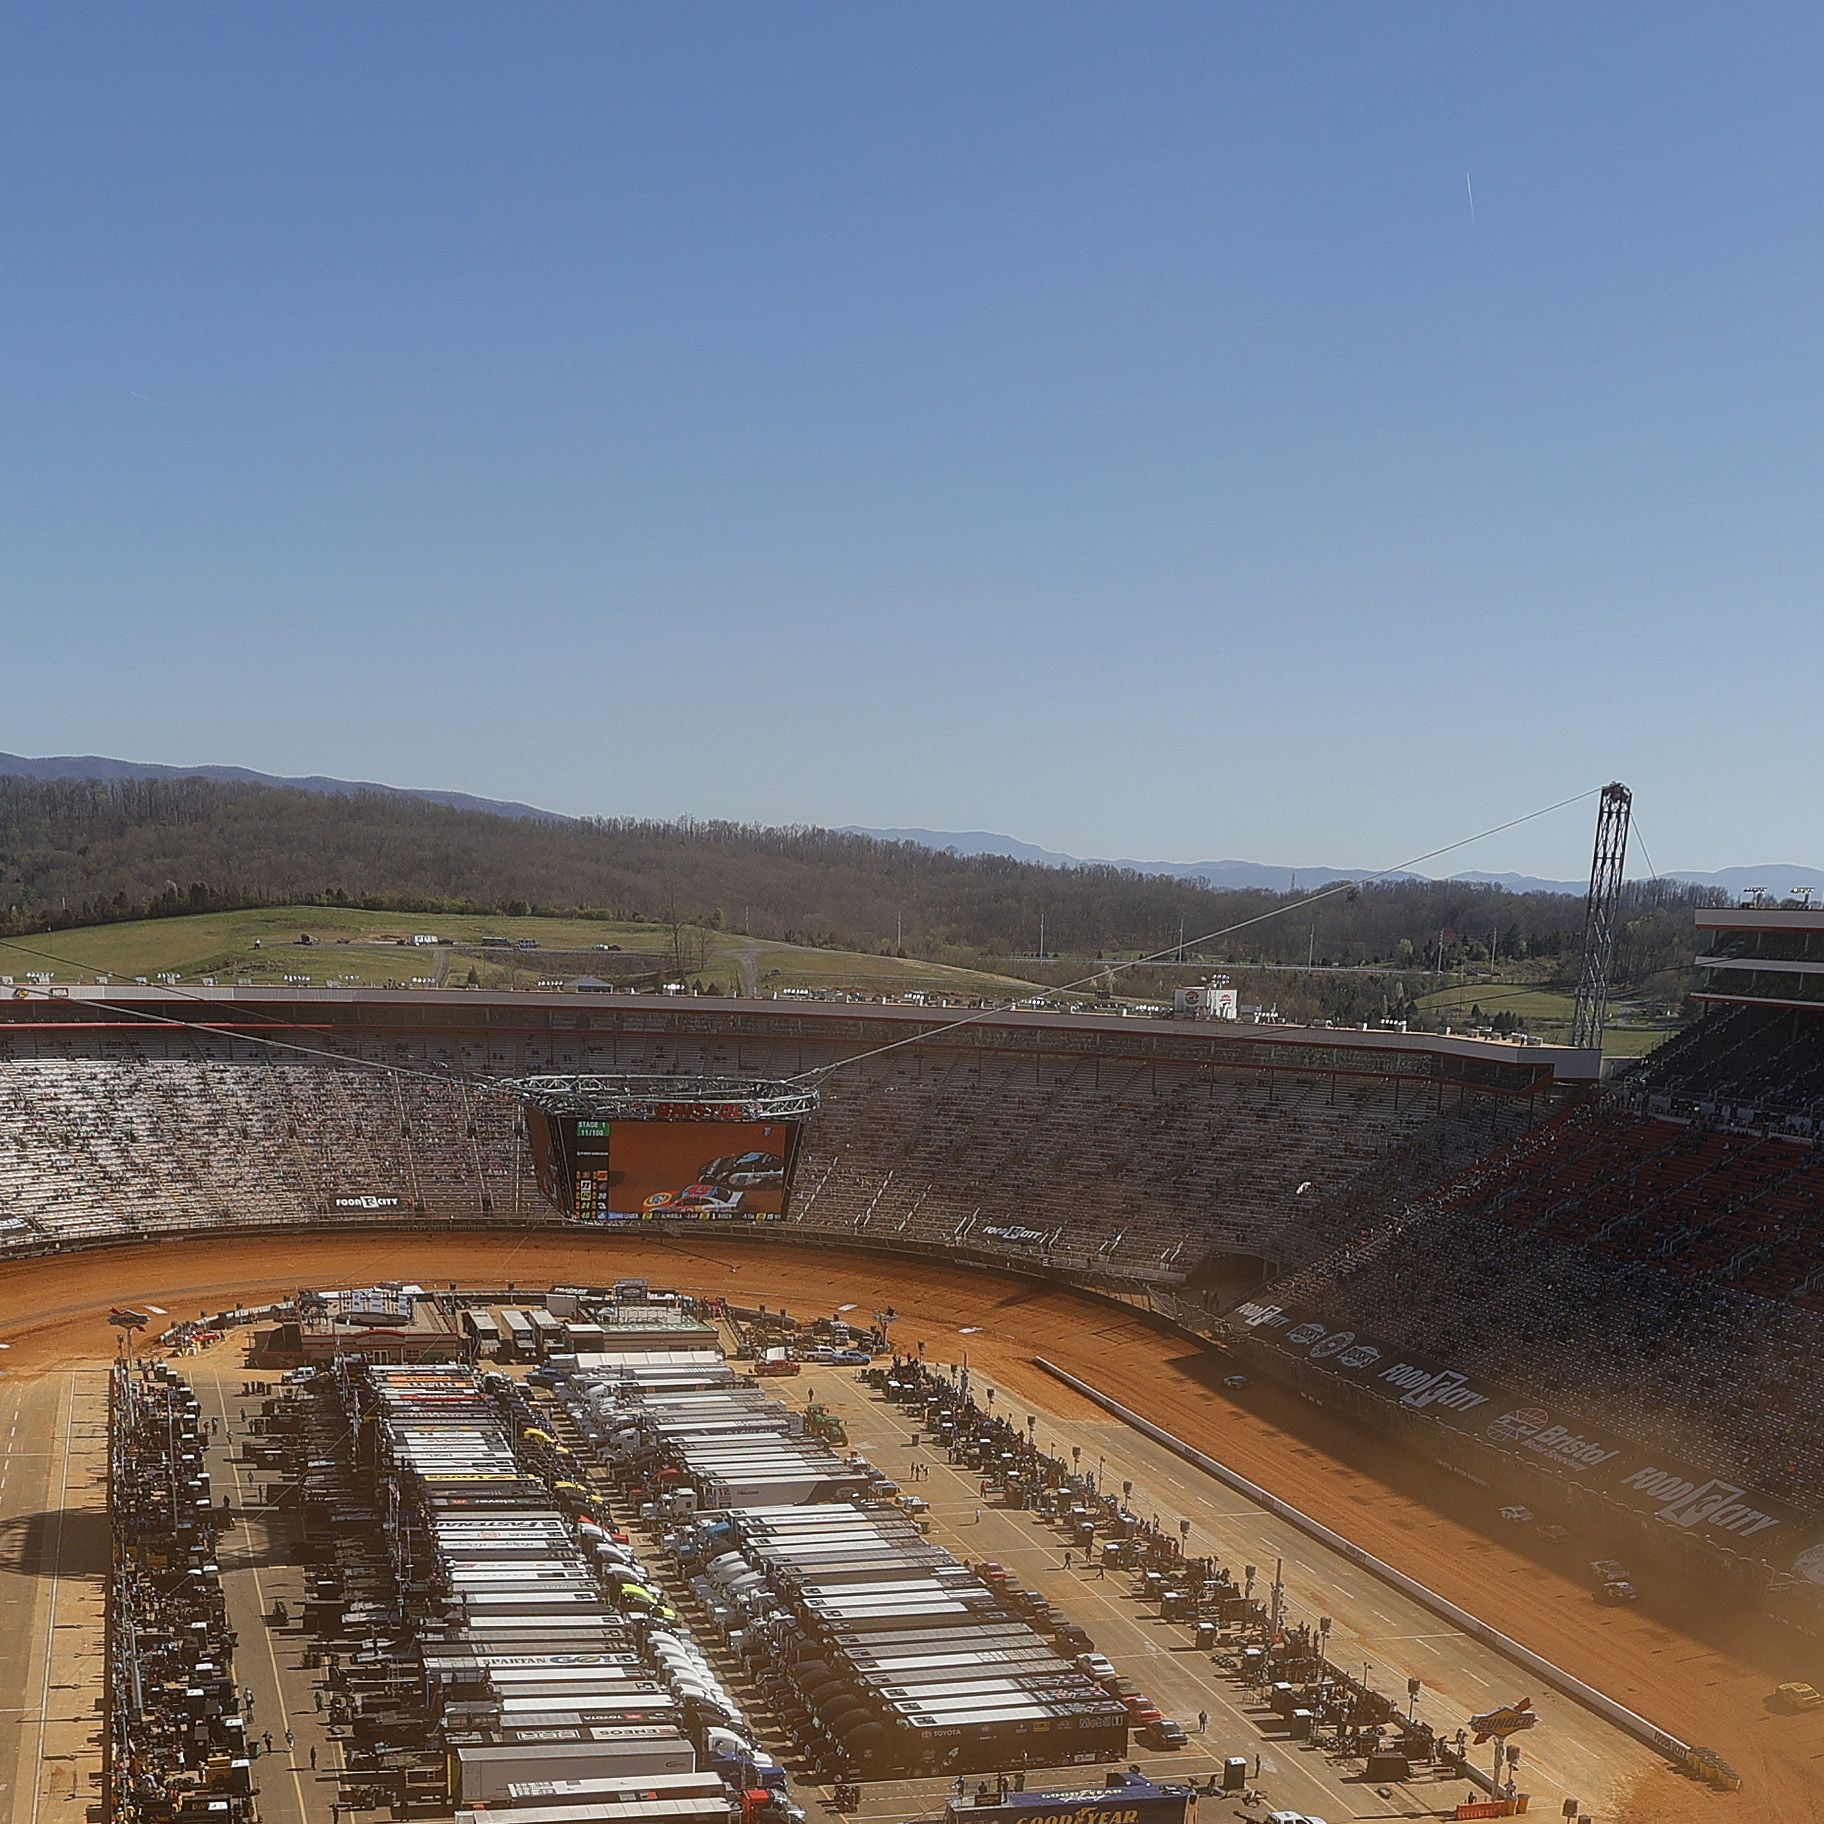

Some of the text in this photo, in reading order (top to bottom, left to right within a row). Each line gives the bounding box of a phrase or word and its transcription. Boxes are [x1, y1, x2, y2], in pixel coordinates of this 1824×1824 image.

[577, 1121, 599, 1129] STAGE
[336, 1197, 398, 1207] FOOD CITY
[1381, 1362, 1489, 1412] FOOD CITY
[1537, 1422, 1621, 1466] Bristol
[1622, 1467, 1779, 1538] FOOD CITY
[934, 1729, 961, 1737] TOYOTA
